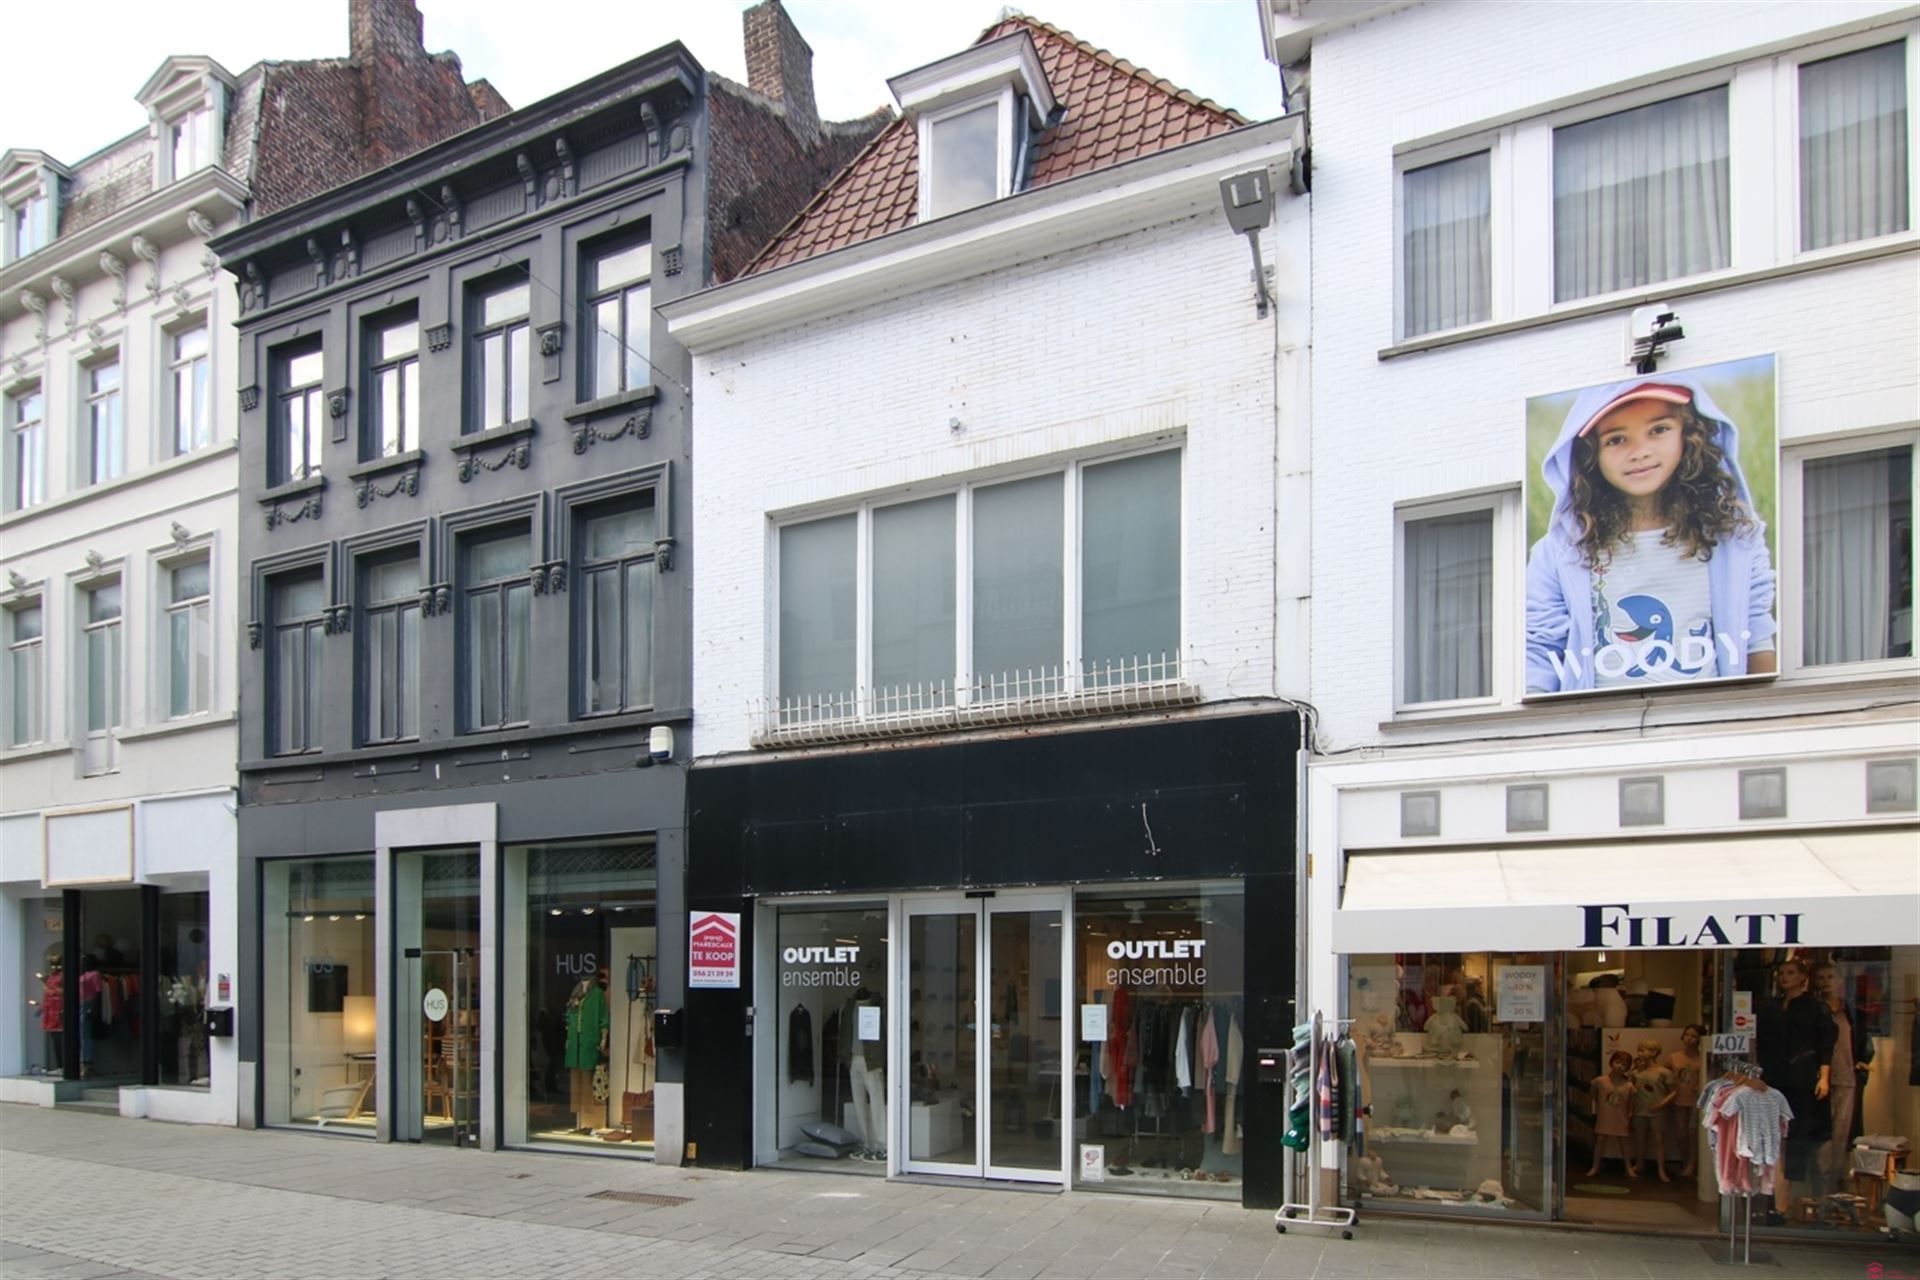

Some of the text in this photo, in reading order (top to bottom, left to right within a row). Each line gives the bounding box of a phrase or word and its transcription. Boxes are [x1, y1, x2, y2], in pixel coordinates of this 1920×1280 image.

[1547, 630, 1751, 682] WOODY
[693, 951, 734, 961] TE KOOP
[783, 946, 859, 963] OUTLET
[1107, 939, 1206, 959] OUTLET
[304, 956, 335, 974] HUS
[556, 953, 597, 975] HUS
[1106, 962, 1207, 985] ensemble
[782, 966, 860, 986] ensemble
[426, 999, 446, 1010] HUS
[1714, 1035, 1746, 1052] 40%
